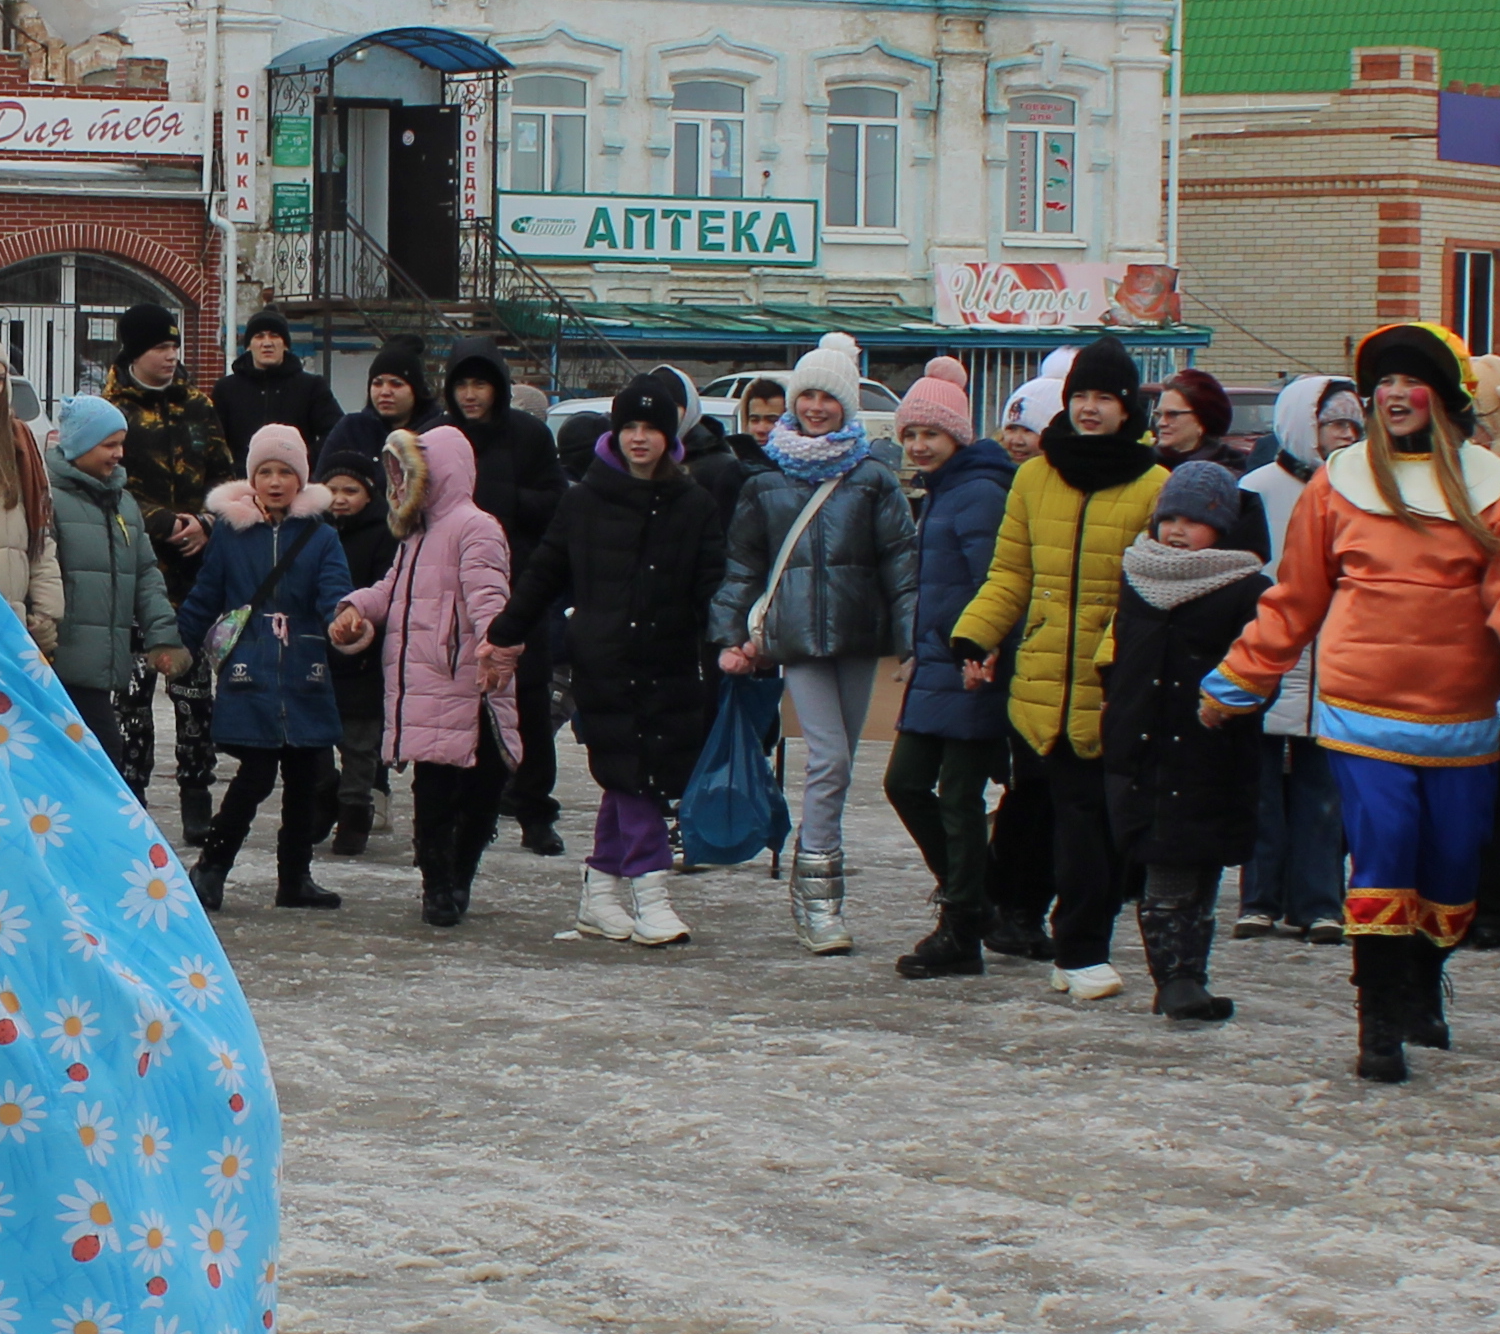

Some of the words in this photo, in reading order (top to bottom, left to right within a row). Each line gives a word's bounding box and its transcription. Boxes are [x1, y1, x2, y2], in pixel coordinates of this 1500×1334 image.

[87, 104, 185, 143] тебя
[1020, 103, 1063, 111] ТОВАРЫ
[236, 84, 250, 211] ОПТИКА
[464, 83, 477, 220] ОРТОПЕДИЯ
[584, 207, 797, 253] АПТЕКА
[953, 266, 1089, 316] Цветы
